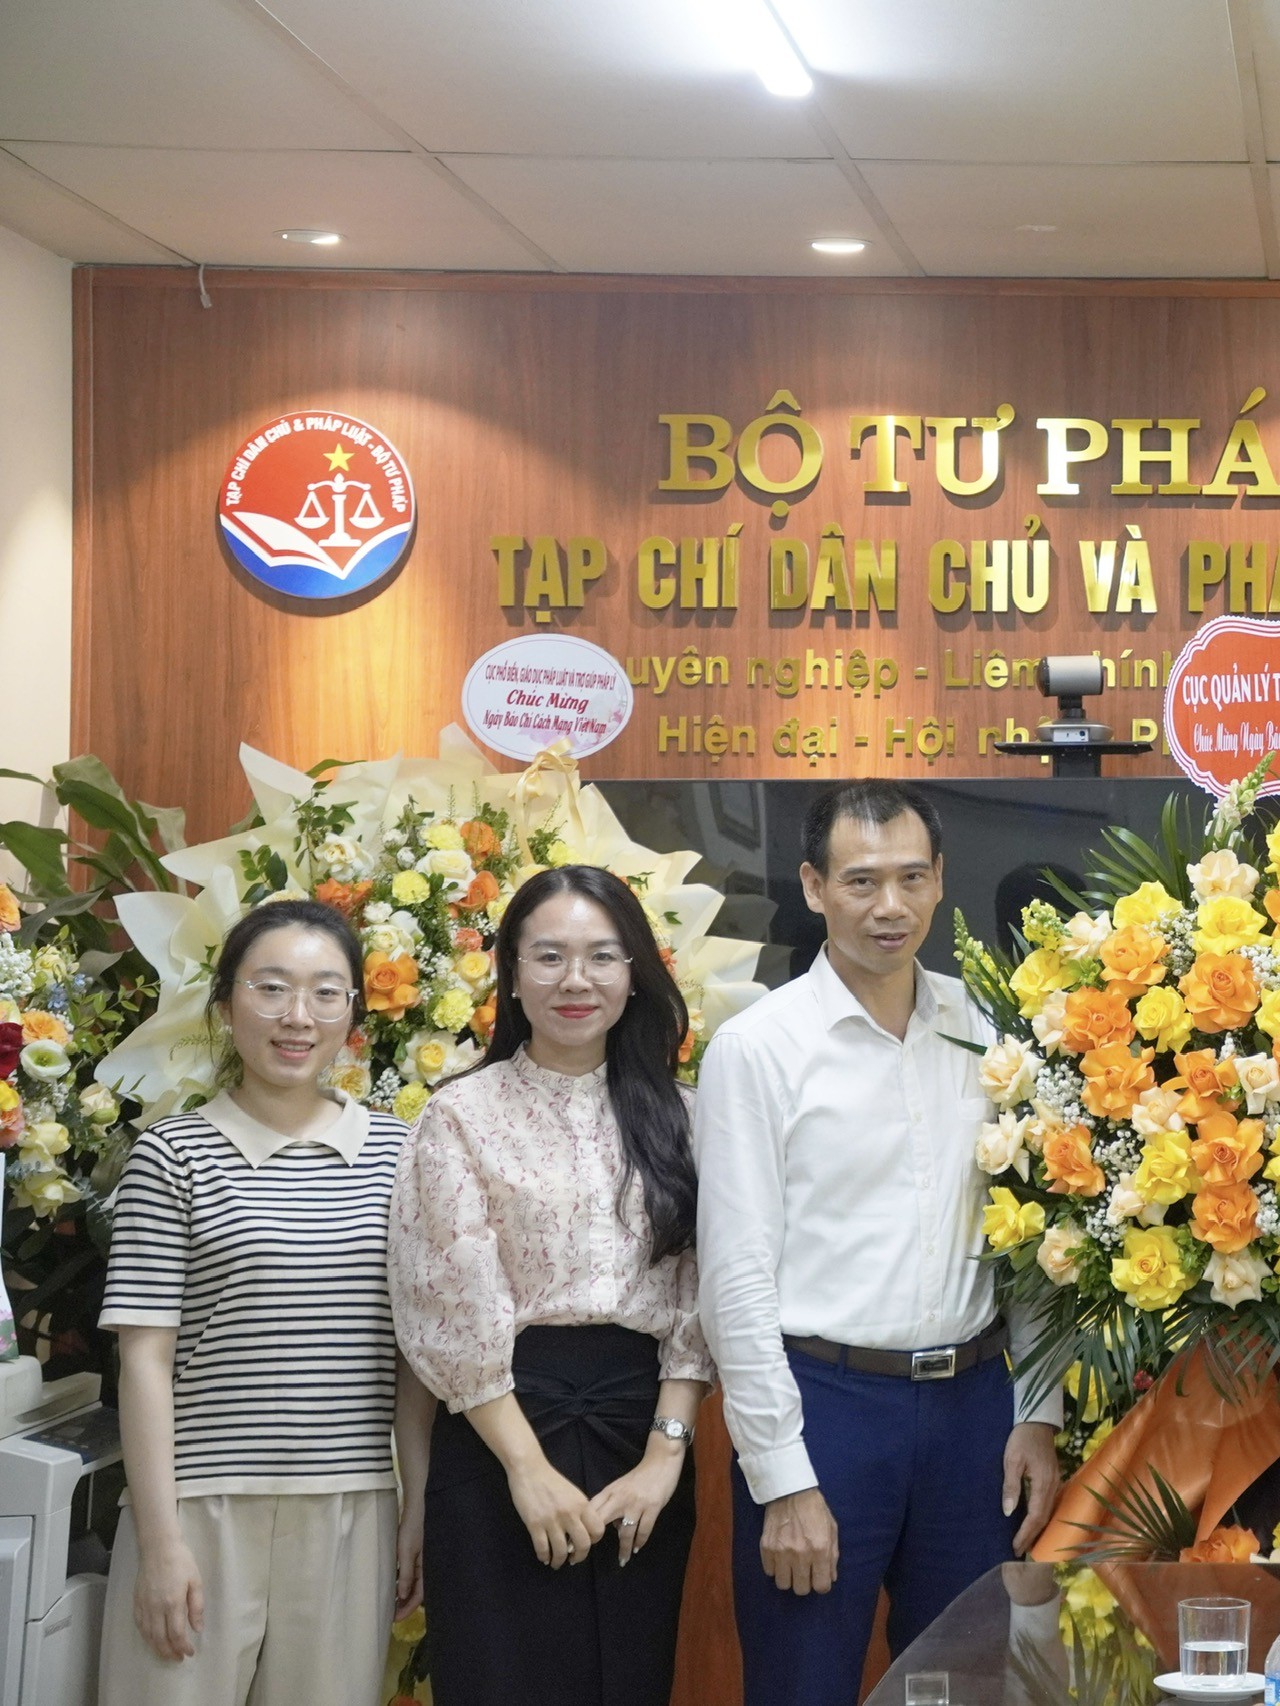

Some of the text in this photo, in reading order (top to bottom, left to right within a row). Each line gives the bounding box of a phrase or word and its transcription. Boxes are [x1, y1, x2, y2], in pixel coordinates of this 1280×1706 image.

[293, 418, 305, 432] &
[657, 388, 825, 518] BỘ
[849, 403, 1016, 498] TƯ
[489, 535, 608, 623] TẠP
[637, 522, 744, 610] CHÍ
[769, 522, 897, 611] DÂN
[927, 513, 1050, 613] CHỦ
[1079, 524, 1157, 614] VÀ
[626, 645, 729, 694] uyên
[746, 648, 899, 698] nghiệp
[1182, 675, 1208, 713] CỤC
[1210, 662, 1251, 712] QUẢN
[1254, 663, 1271, 702] LÝ
[503, 709, 518, 727] Báo
[519, 711, 534, 728] Chí
[532, 712, 551, 730] Cách
[506, 688, 589, 714] Chúc Mừng
[658, 714, 756, 763] Hiện
[772, 717, 838, 766] đại
[885, 716, 956, 766] Hội
[1193, 723, 1213, 753] Chúc
[1214, 722, 1238, 758] Mừng
[1240, 721, 1264, 758] Ngày
